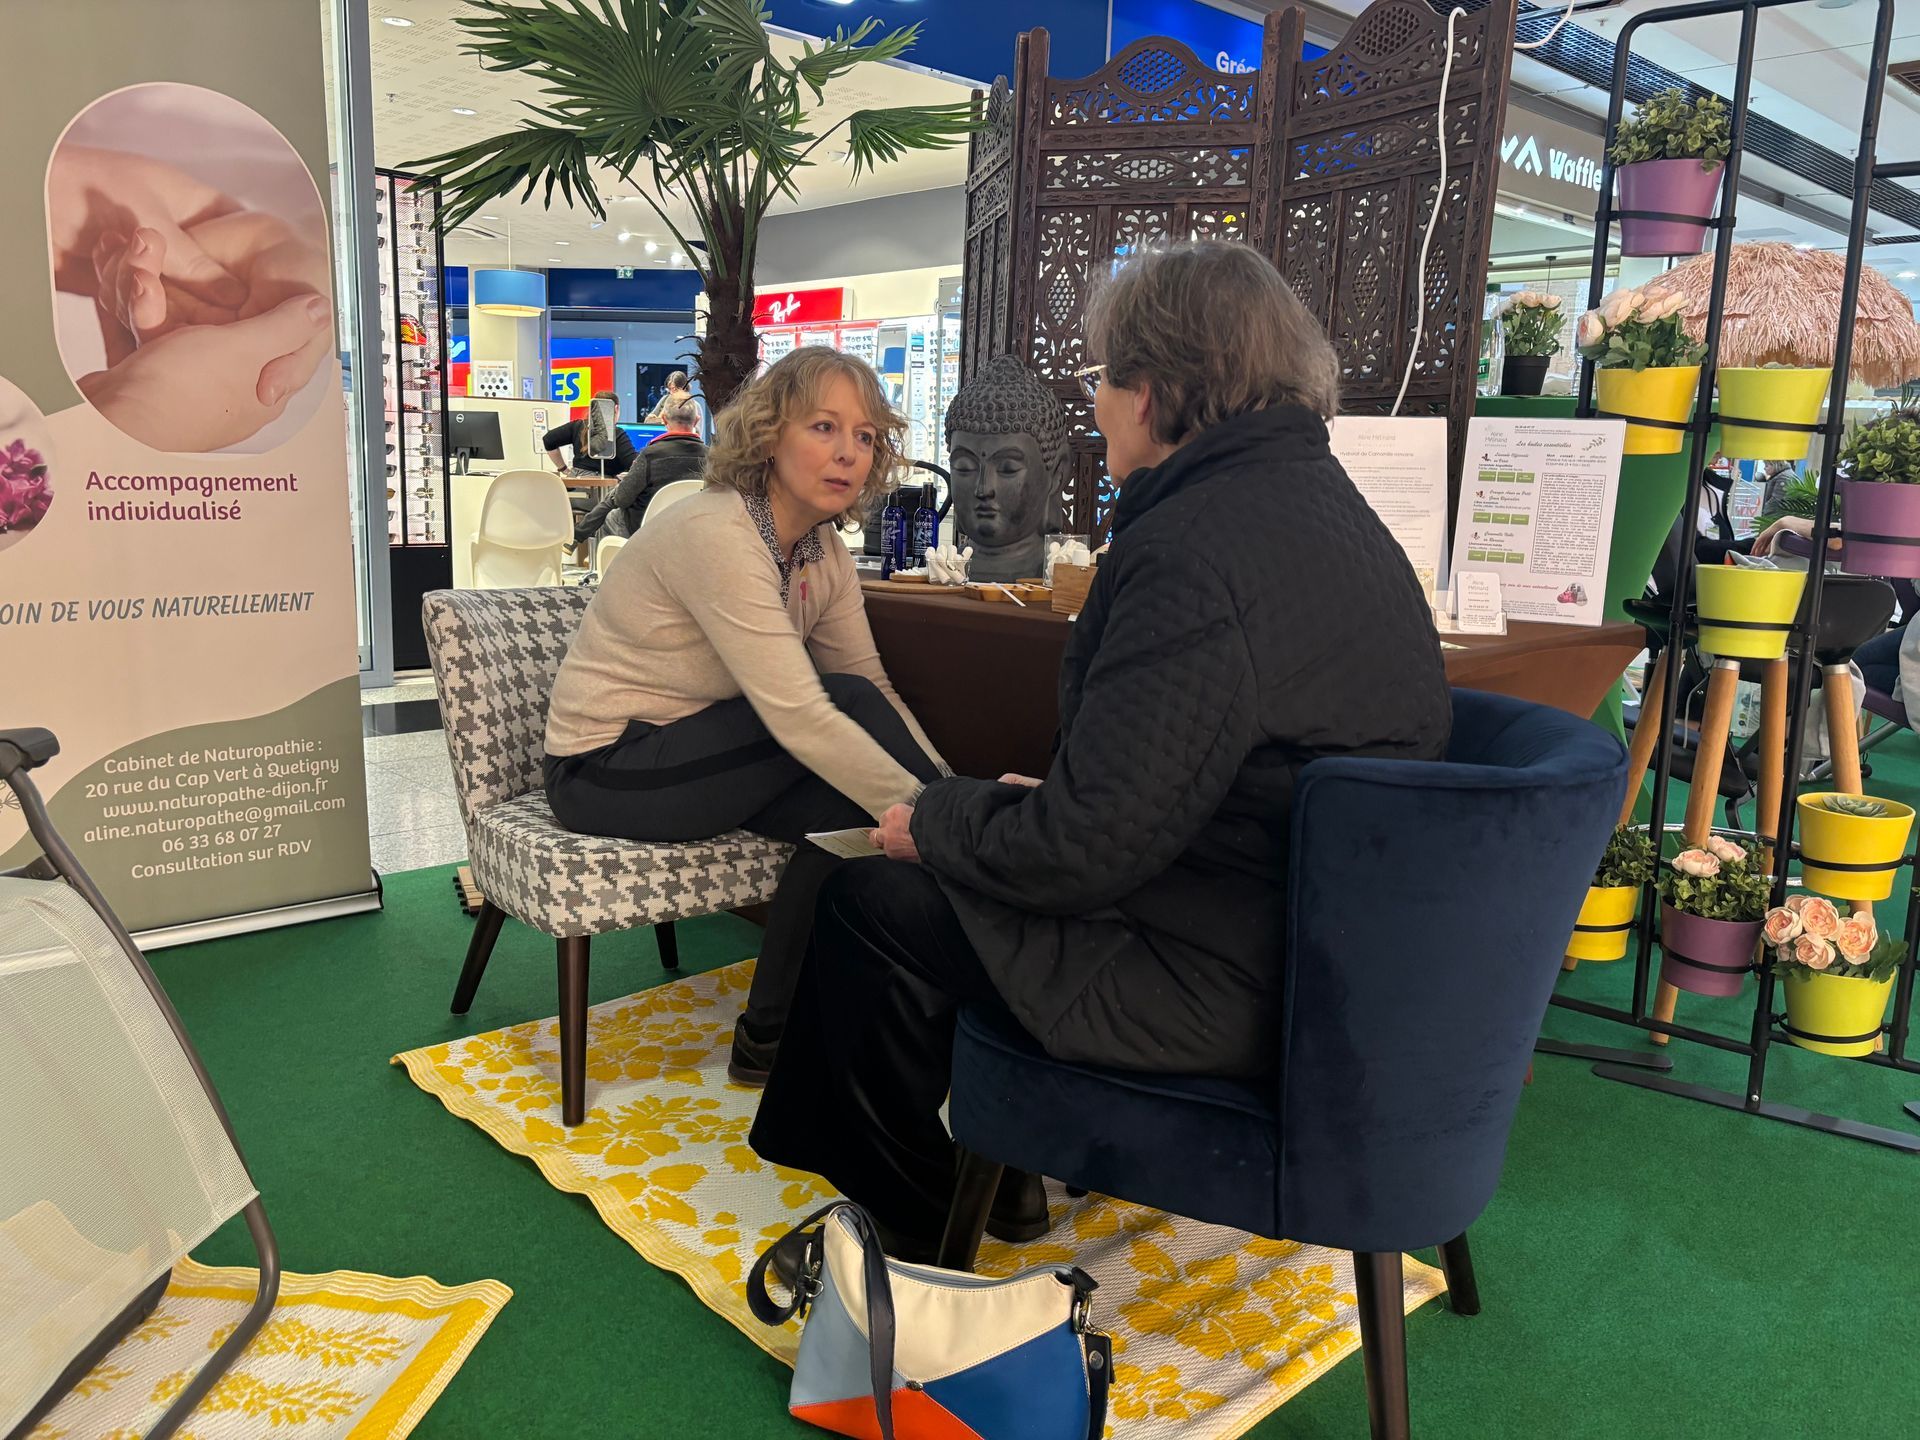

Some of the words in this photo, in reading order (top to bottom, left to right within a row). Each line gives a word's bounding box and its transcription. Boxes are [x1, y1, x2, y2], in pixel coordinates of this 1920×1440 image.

[85, 471, 299, 497] Accompagnement
[87, 500, 242, 521] individualisé
[51, 601, 79, 623] DE
[88, 598, 145, 621] VOUS
[152, 591, 315, 618] NATURELLEMENT
[85, 783, 109, 799] 20
[113, 780, 144, 795] rue
[148, 775, 171, 792] du
[175, 772, 210, 792] Cap
[214, 766, 249, 783] Vert
[252, 763, 263, 779] à
[267, 757, 340, 779] Quetigny
[103, 753, 175, 774] Cabinet
[179, 751, 200, 766] de
[103, 777, 328, 818] www.naturopathe-dijon.fr
[84, 796, 346, 843] aline.naturopathe@gmail.com
[162, 838, 184, 853] 06
[189, 834, 210, 849] 33
[214, 831, 236, 846] 68
[239, 828, 259, 842] 07
[263, 824, 283, 839] 27
[131, 850, 245, 879] Consultation
[248, 847, 274, 862] sur
[277, 839, 313, 858] RDV
